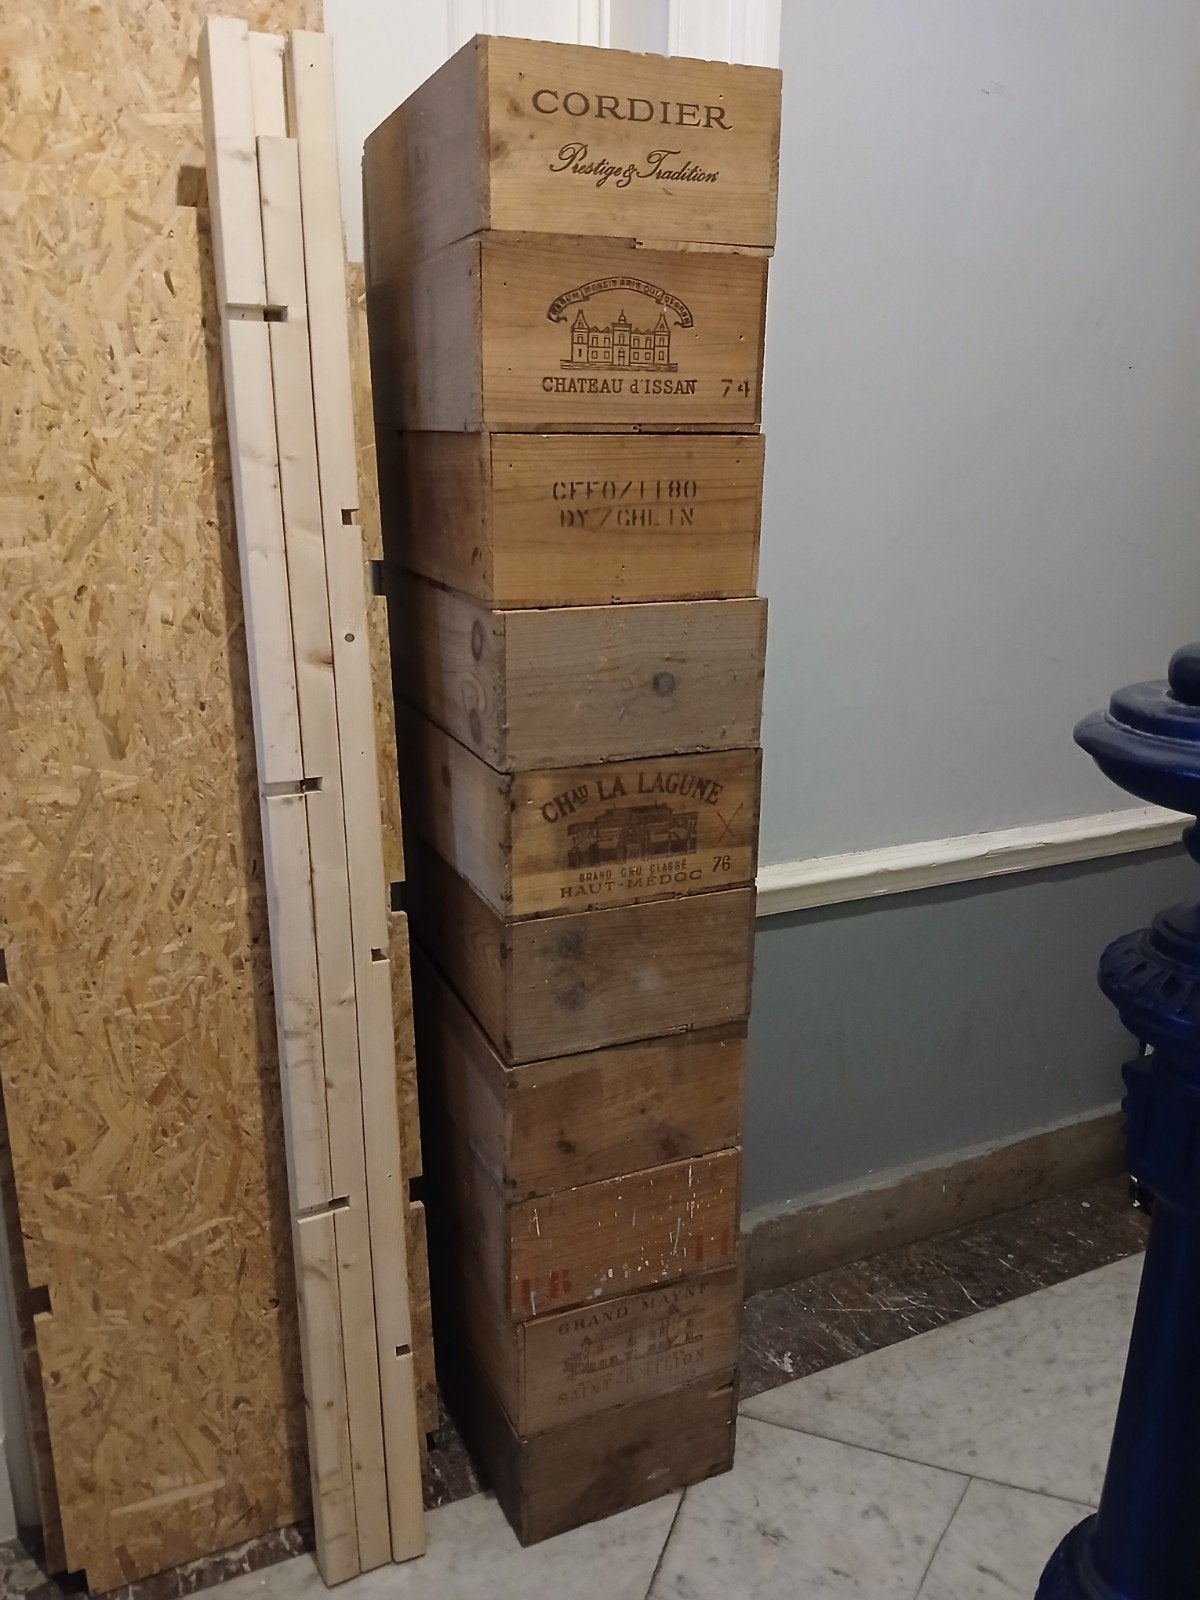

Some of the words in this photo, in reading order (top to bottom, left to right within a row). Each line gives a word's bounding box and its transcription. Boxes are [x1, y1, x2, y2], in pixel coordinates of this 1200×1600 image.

[531, 89, 733, 130] CORDIER
[549, 142, 621, 188] Prestige
[616, 166, 638, 188] &
[637, 150, 719, 183] Tradition
[541, 376, 622, 395] CHATEAU
[629, 378, 698, 395] d'ISSAN
[721, 379, 750, 399] 74
[596, 775, 628, 801] LA
[638, 771, 724, 806] LAGUNE
[712, 854, 731, 873] 76
[558, 1306, 629, 1336] GRAND
